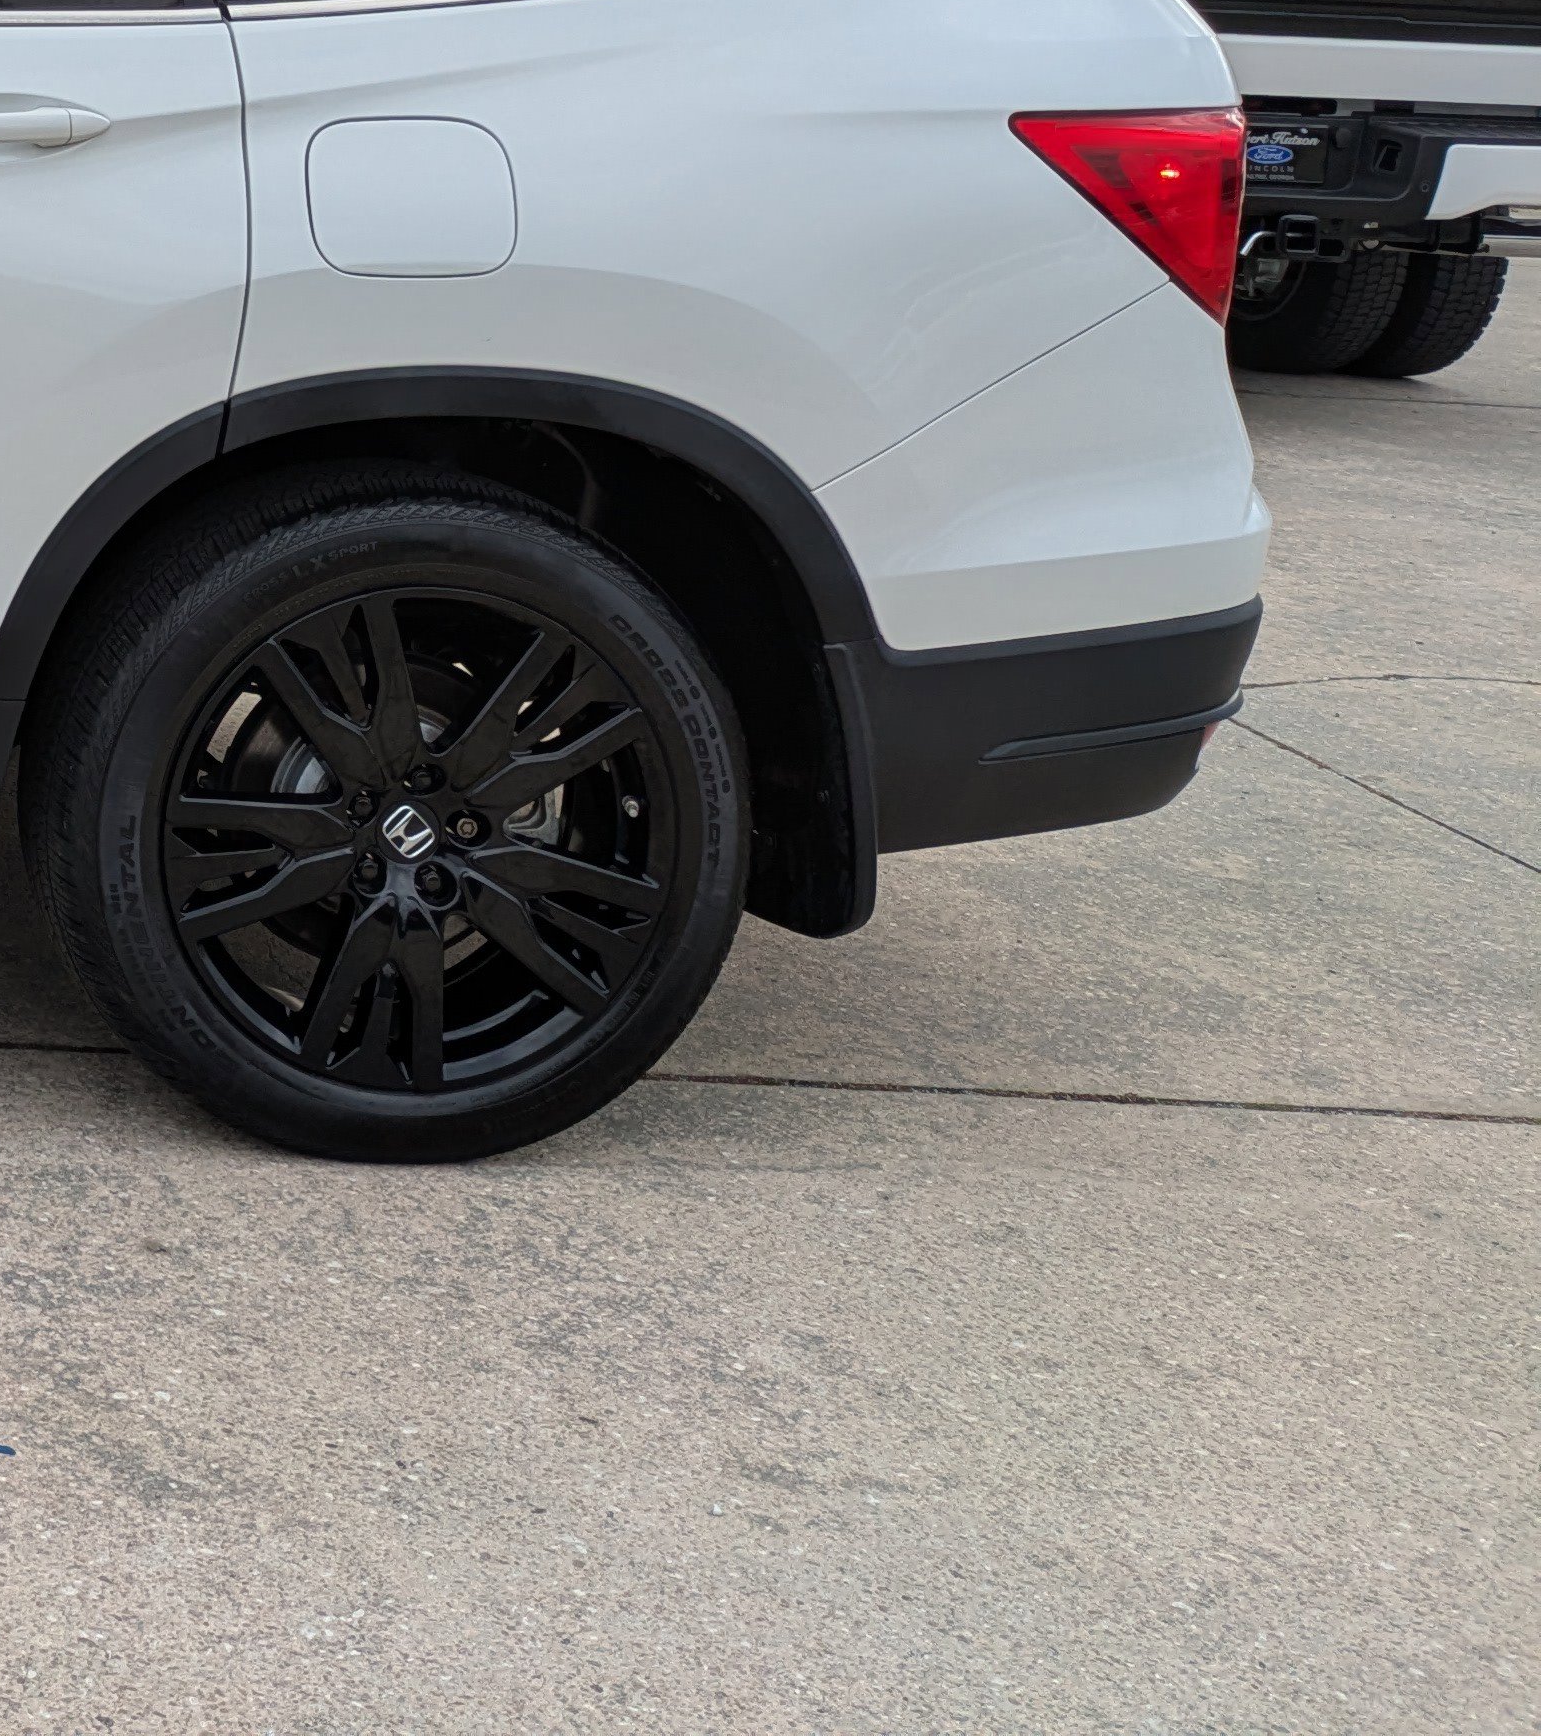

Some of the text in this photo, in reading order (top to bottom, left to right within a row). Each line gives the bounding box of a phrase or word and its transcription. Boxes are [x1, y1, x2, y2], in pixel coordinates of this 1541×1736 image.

[1253, 146, 1285, 160] Ford
[1248, 165, 1295, 173] INCOLN
[683, 714, 721, 869] CONTACT
